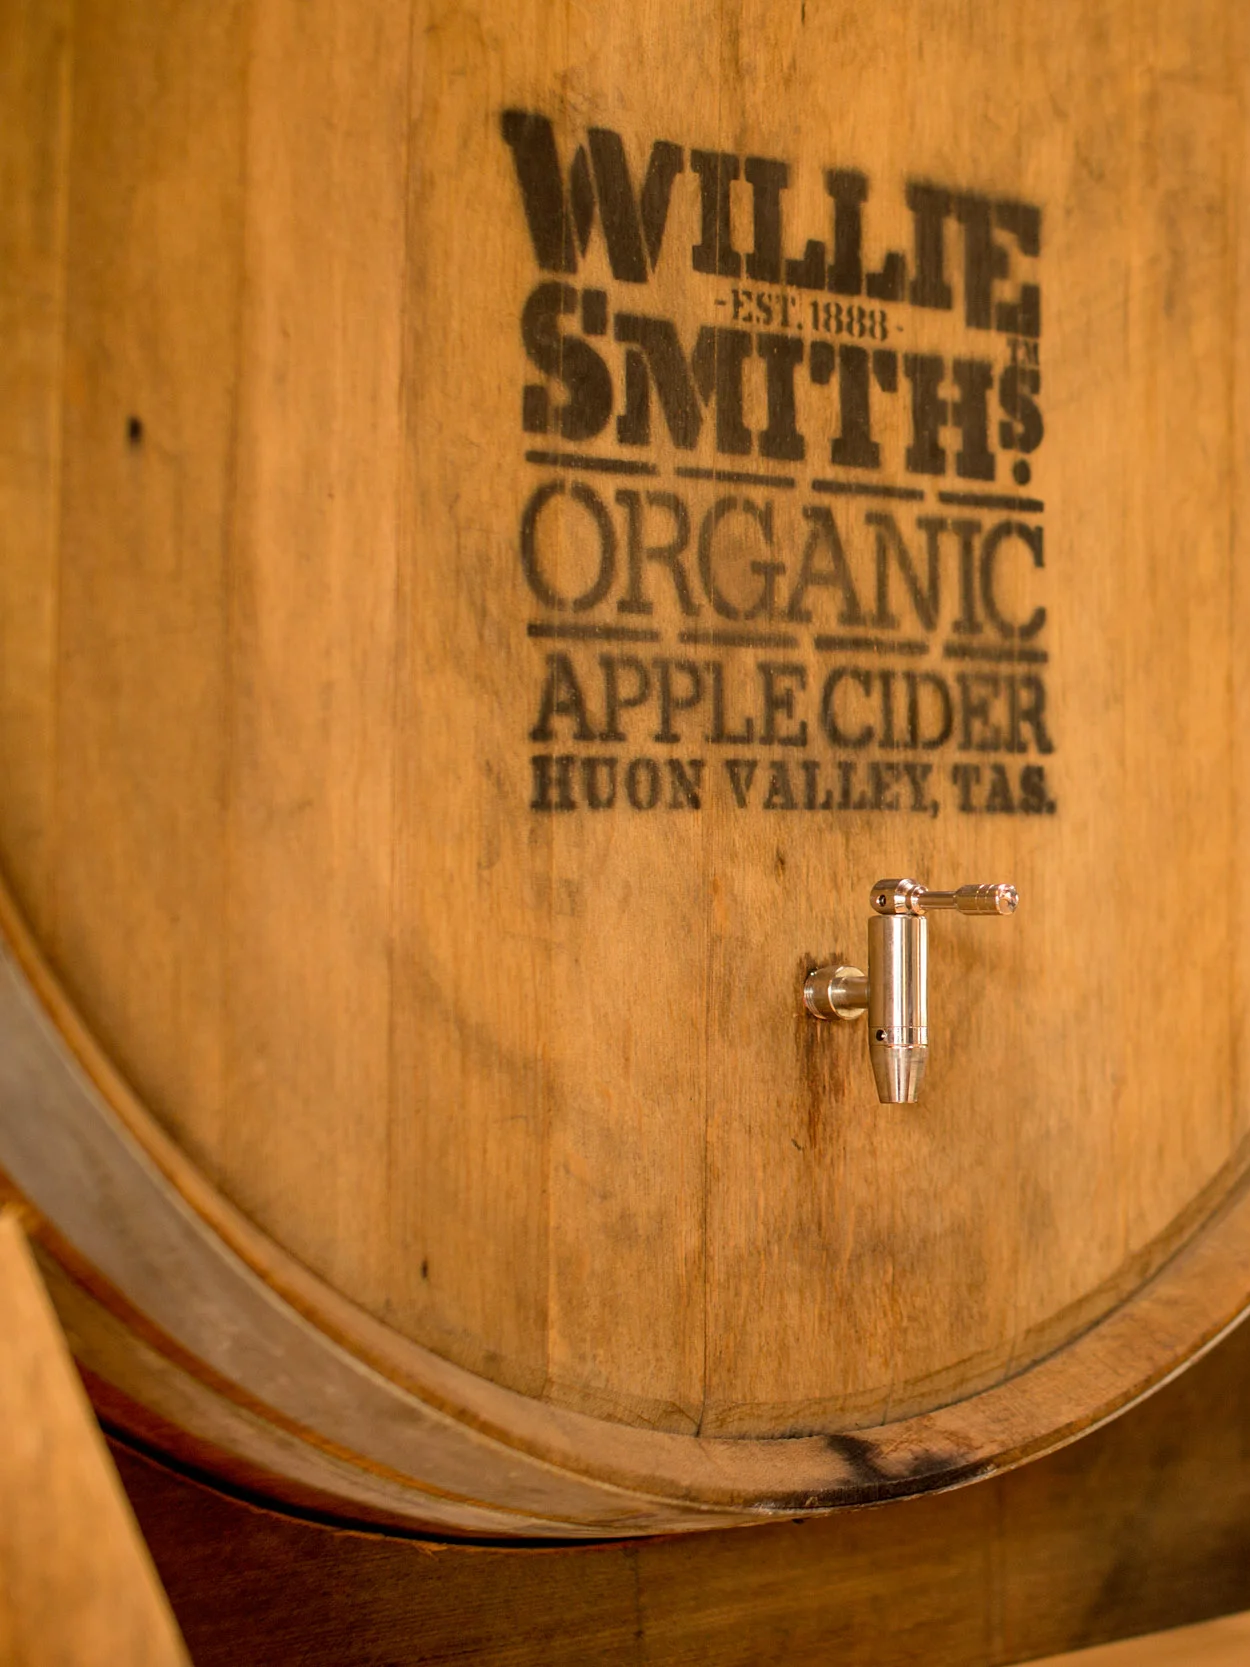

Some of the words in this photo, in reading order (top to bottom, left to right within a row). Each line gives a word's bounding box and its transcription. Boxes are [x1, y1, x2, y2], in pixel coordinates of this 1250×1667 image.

[502, 109, 1041, 338] WILLIE
[520, 479, 1046, 640] ORGANIC
[530, 652, 807, 747] APPLE
[820, 667, 1054, 754] CIDER
[530, 755, 706, 812] HUON
[725, 760, 939, 817] VALLEY,
[952, 764, 1056, 814] TAS.
